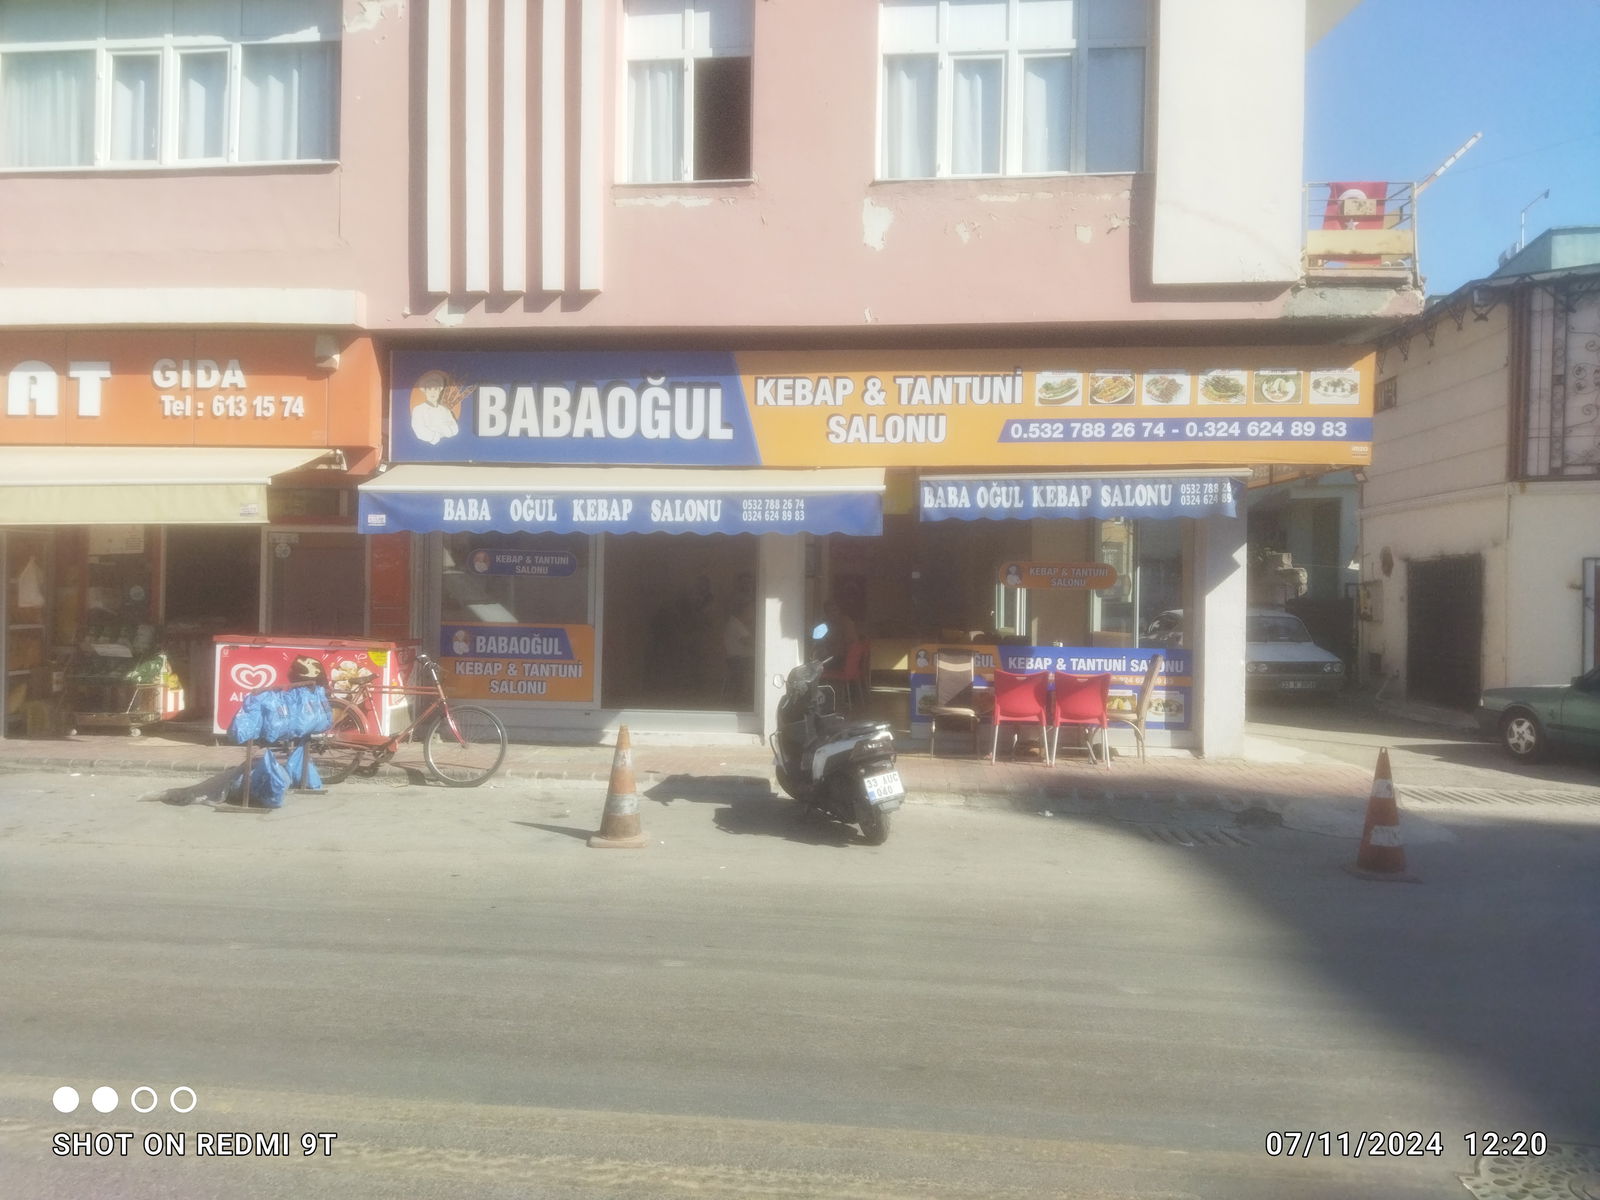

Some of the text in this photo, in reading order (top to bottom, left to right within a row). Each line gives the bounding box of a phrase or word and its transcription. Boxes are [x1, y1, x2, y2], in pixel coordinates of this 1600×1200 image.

[152, 358, 247, 389] GIDA
[7, 360, 111, 416] AT
[756, 370, 1023, 406] KEBAP & TANTUNİ
[161, 395, 191, 416] Tel
[212, 395, 247, 417] 613
[253, 395, 275, 417] 15
[281, 395, 305, 417] 74
[477, 376, 734, 440] BABAOĞUL
[828, 414, 947, 444] SALONU
[1011, 423, 1063, 438] 0.532
[1070, 423, 1105, 437] 788
[1112, 423, 1135, 437] 26
[1142, 422, 1165, 437] 74
[1186, 421, 1240, 437] 0.324
[1247, 421, 1284, 437] 624
[1291, 421, 1315, 436] 89
[1322, 421, 1347, 436] 83
[923, 483, 1172, 509] BABA OĞUL KEBAP SALONU
[1181, 484, 1200, 494] 0532
[1204, 483, 1219, 494] 788
[743, 499, 804, 510] 0532 788 26 74
[1181, 495, 1200, 505] 0324
[1203, 494, 1218, 504] 624
[443, 495, 722, 522] BABA OĞUL KEBAP SALONU
[743, 510, 804, 521] 0324 624 89 83
[496, 555, 522, 564] KEBAP
[525, 555, 532, 564] &
[515, 565, 549, 574] SALONU
[1051, 578, 1086, 587] SALONU
[476, 634, 563, 655] BABAOĞUL
[456, 661, 583, 678] KEBAP & TANTUNİ
[1009, 656, 1052, 670] KEBAP
[1056, 657, 1067, 670] &
[1070, 656, 1126, 671] TANTUNİ
[490, 680, 547, 694] SALONU
